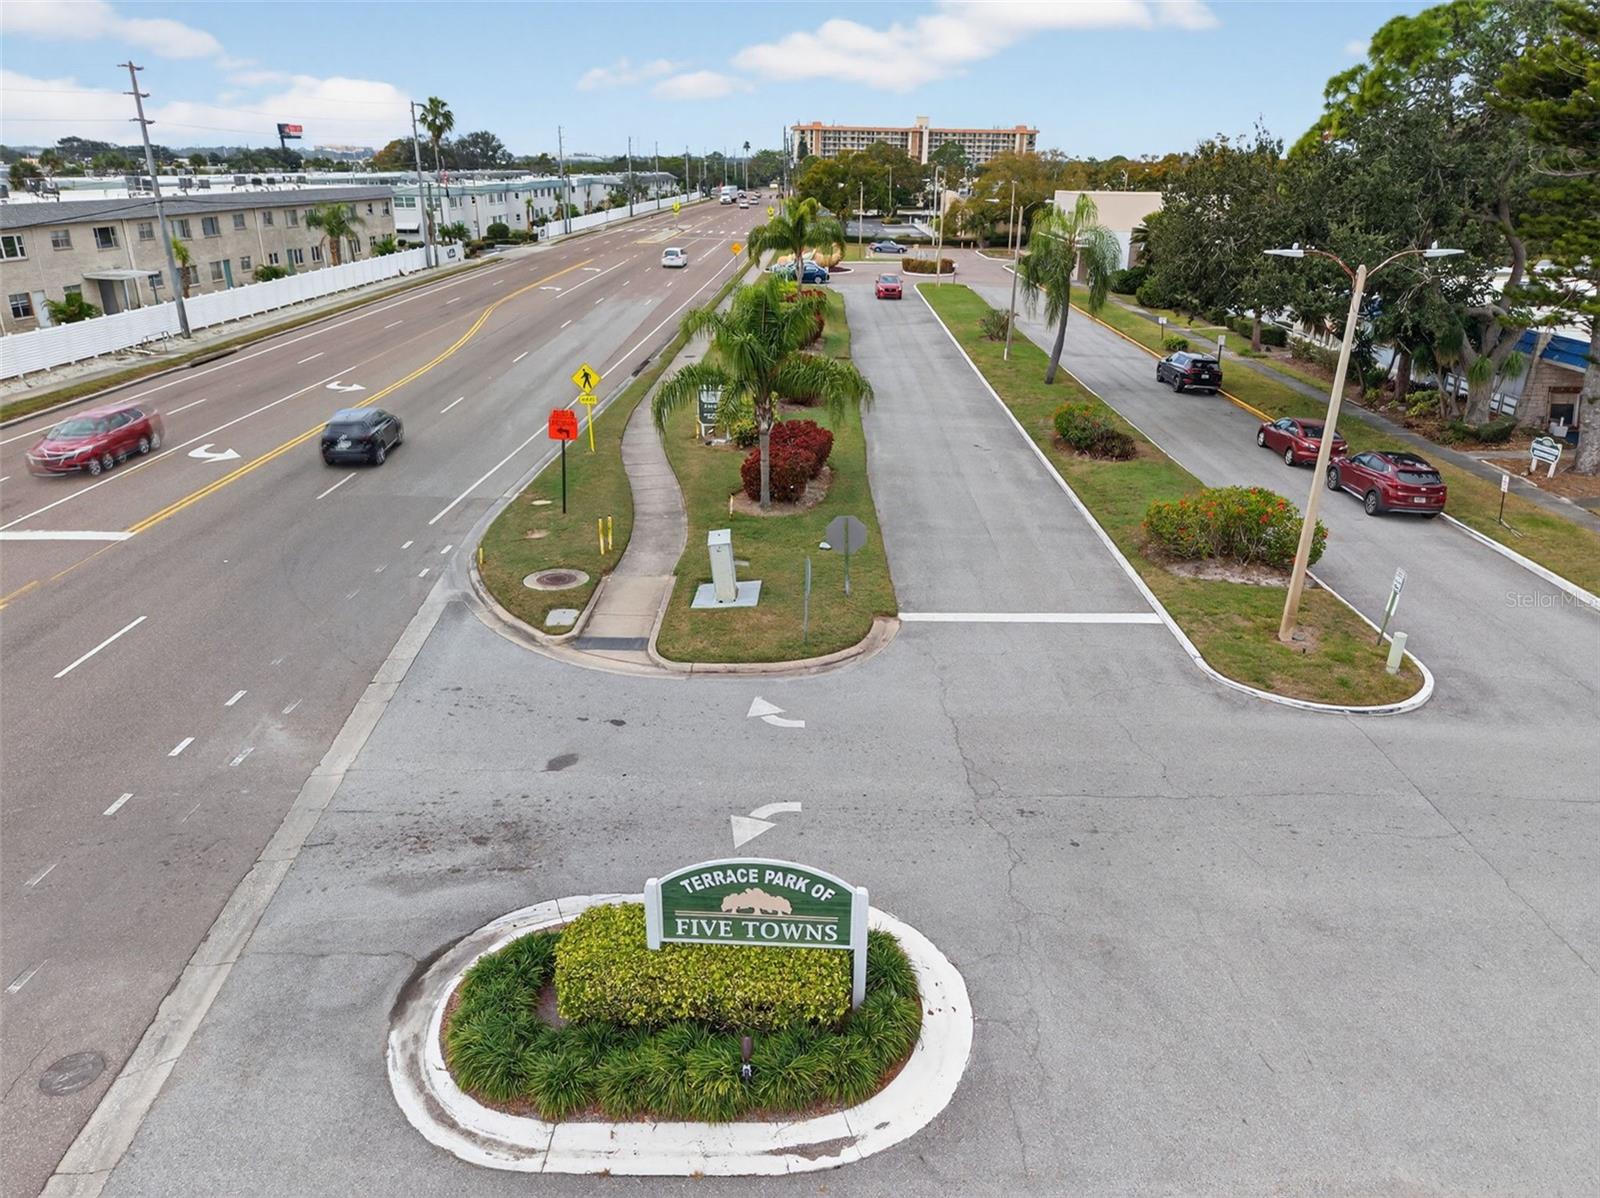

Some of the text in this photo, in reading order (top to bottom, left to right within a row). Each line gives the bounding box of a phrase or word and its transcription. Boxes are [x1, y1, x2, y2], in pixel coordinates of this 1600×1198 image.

[680, 868, 836, 902] TERRACE PARK OF
[675, 918, 838, 942] FIVE TOWNS
